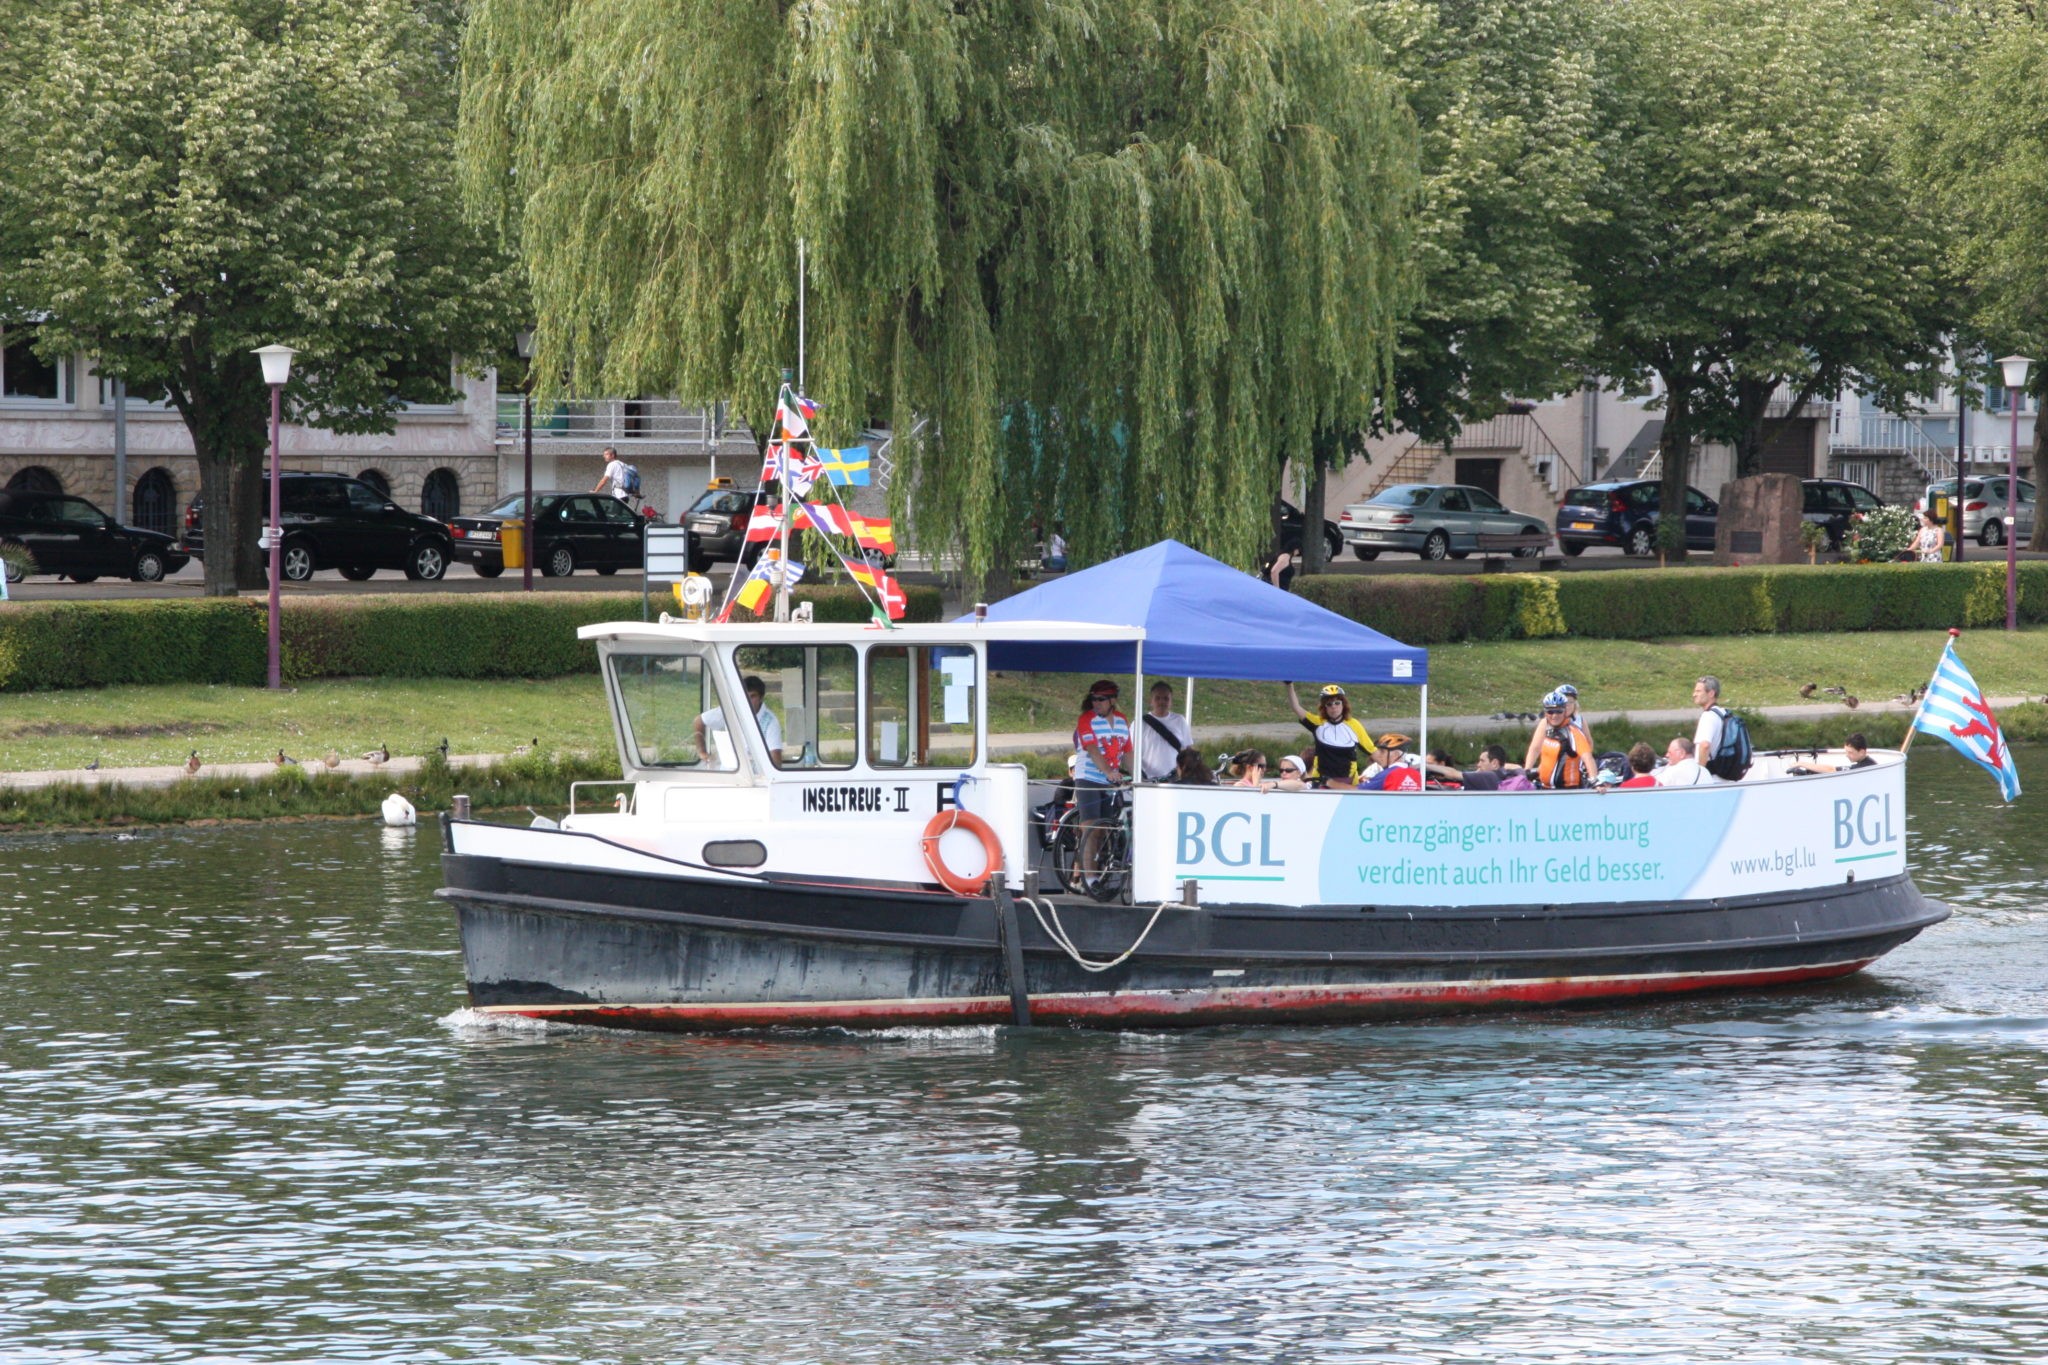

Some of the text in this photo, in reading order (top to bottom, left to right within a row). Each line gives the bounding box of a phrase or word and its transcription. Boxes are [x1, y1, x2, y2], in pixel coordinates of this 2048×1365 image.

[802, 787, 909, 812] INSELTREUE II
[1358, 814, 1650, 851] Grenzgänger: In Luxemburg
[1834, 793, 1897, 849] BGL
[1176, 811, 1285, 866] BGL
[1357, 855, 1665, 885] verdient auch Ihr Geld besser.
[1730, 847, 1816, 876] www.bgl.lu
